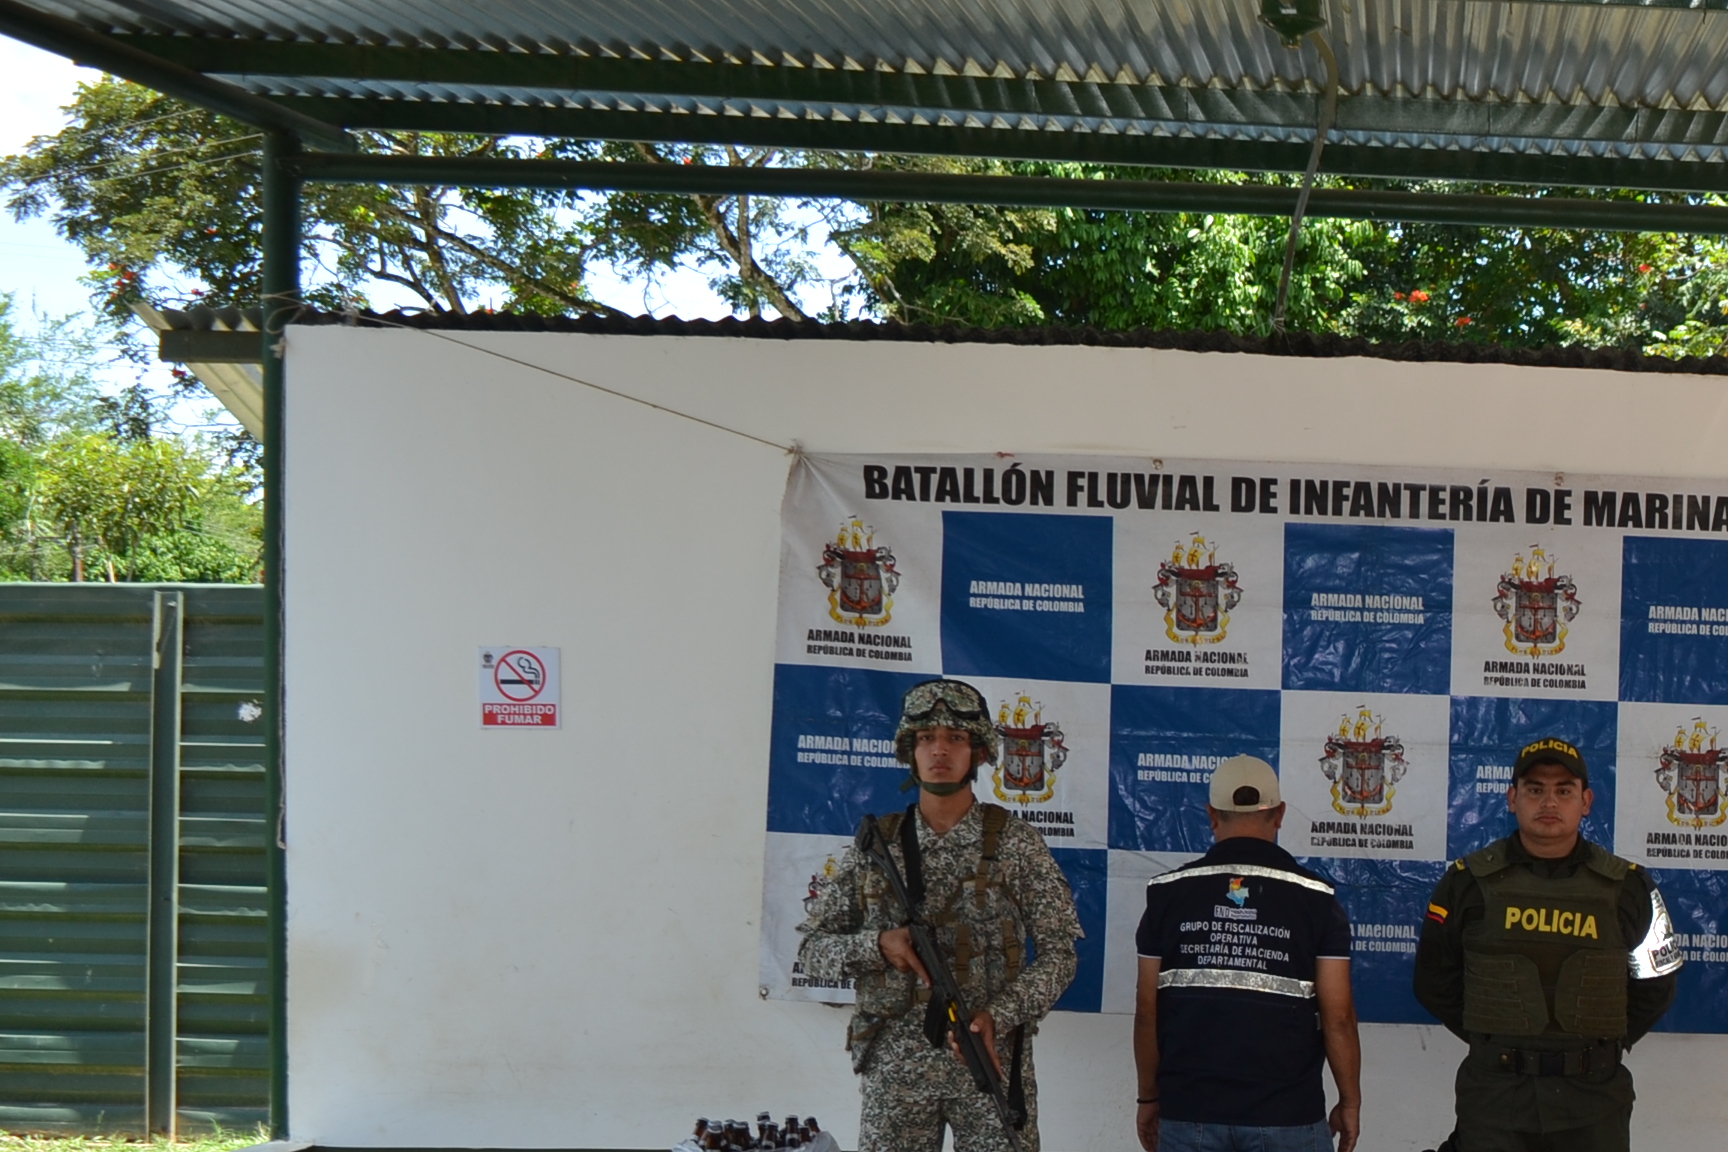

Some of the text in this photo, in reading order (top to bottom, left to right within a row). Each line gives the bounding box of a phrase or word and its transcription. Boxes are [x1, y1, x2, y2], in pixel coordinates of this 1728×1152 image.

[863, 462, 1055, 507] BATALLÓN
[1066, 470, 1220, 512] FLUVIAL
[1230, 476, 1278, 514] DE
[1289, 478, 1515, 523] INFANTERÍA
[1525, 488, 1572, 526] DE
[969, 580, 1084, 599] ARMADA NACIONAL
[969, 597, 1085, 613] REPÚBLICA DE COLOMBIA
[1311, 592, 1424, 610] ARMADA NACIONAL
[1311, 609, 1424, 624] REPÚBLICA DE COLOMBIA
[1648, 605, 1699, 621] ARMADA
[1648, 621, 1698, 635] REPÚBLICA
[1699, 624, 1711, 635] DE
[807, 628, 912, 648] ARMADA NACIONAL
[806, 644, 913, 661] REPÚBLICA DE COLOMBIA
[1144, 649, 1249, 664] ARMADA NACIONAL
[1193, 666, 1203, 676] DE
[1205, 667, 1249, 678] COLOMBIA
[1483, 660, 1586, 676] ARMADA NACIONAL
[1531, 678, 1541, 688] DE
[1543, 678, 1586, 690] COLOMBIA
[484, 704, 555, 715] PROHIBIDO
[497, 714, 542, 724] FUMAR
[797, 734, 850, 752] ARMADA
[1520, 740, 1580, 760] POLICIA
[797, 752, 863, 767] REPÚBLICA DE
[1137, 752, 1189, 769] ARMADA
[1137, 769, 1188, 783] REPÚBLICA
[1190, 772, 1202, 783] DE
[1476, 765, 1514, 780] ARMA
[1021, 810, 1075, 825] NACIONAL
[1310, 821, 1414, 836] ARMADA NACIONAL
[1358, 838, 1369, 848] DE
[1370, 839, 1414, 850] COLOMBIA
[1646, 832, 1692, 846] ARMADA
[1693, 849, 1703, 859] DE
[1180, 921, 1291, 939] GRUPO DE FISCALIZACIÓN
[1504, 905, 1598, 940] POLICIA
[1210, 932, 1258, 945] OPERATIVA
[1357, 923, 1417, 939] NACIONAL
[1180, 942, 1290, 962] SECRETARÍA DE HACIENDA
[1355, 940, 1417, 953] DE COLOMBIA
[1197, 954, 1268, 970] DEPARTAMENTAL
[1690, 950, 1701, 961] DE
[840, 980, 851, 990] DE
